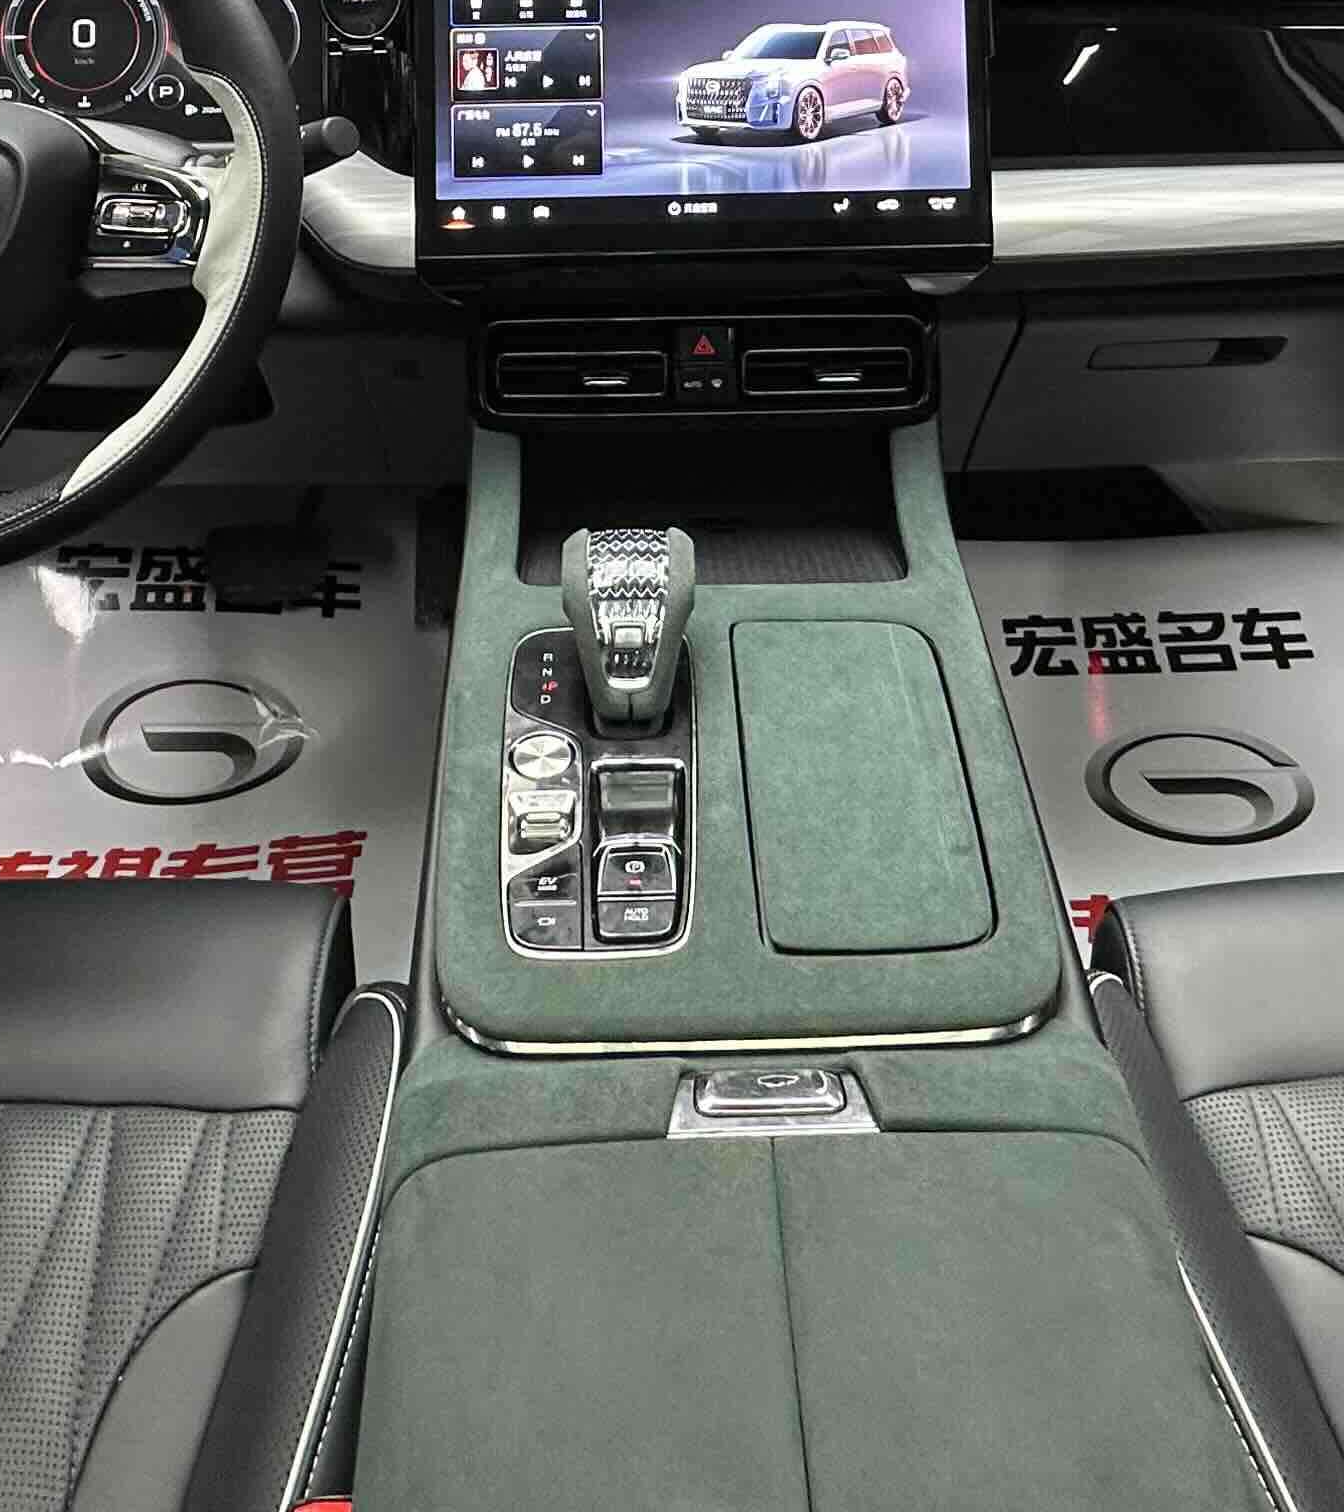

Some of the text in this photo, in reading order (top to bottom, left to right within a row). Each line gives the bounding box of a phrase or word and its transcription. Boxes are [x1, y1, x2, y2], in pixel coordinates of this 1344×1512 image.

[72, 18, 96, 49] 0
[159, 86, 174, 99] P
[1001, 607, 1315, 677] 宏盛名车
